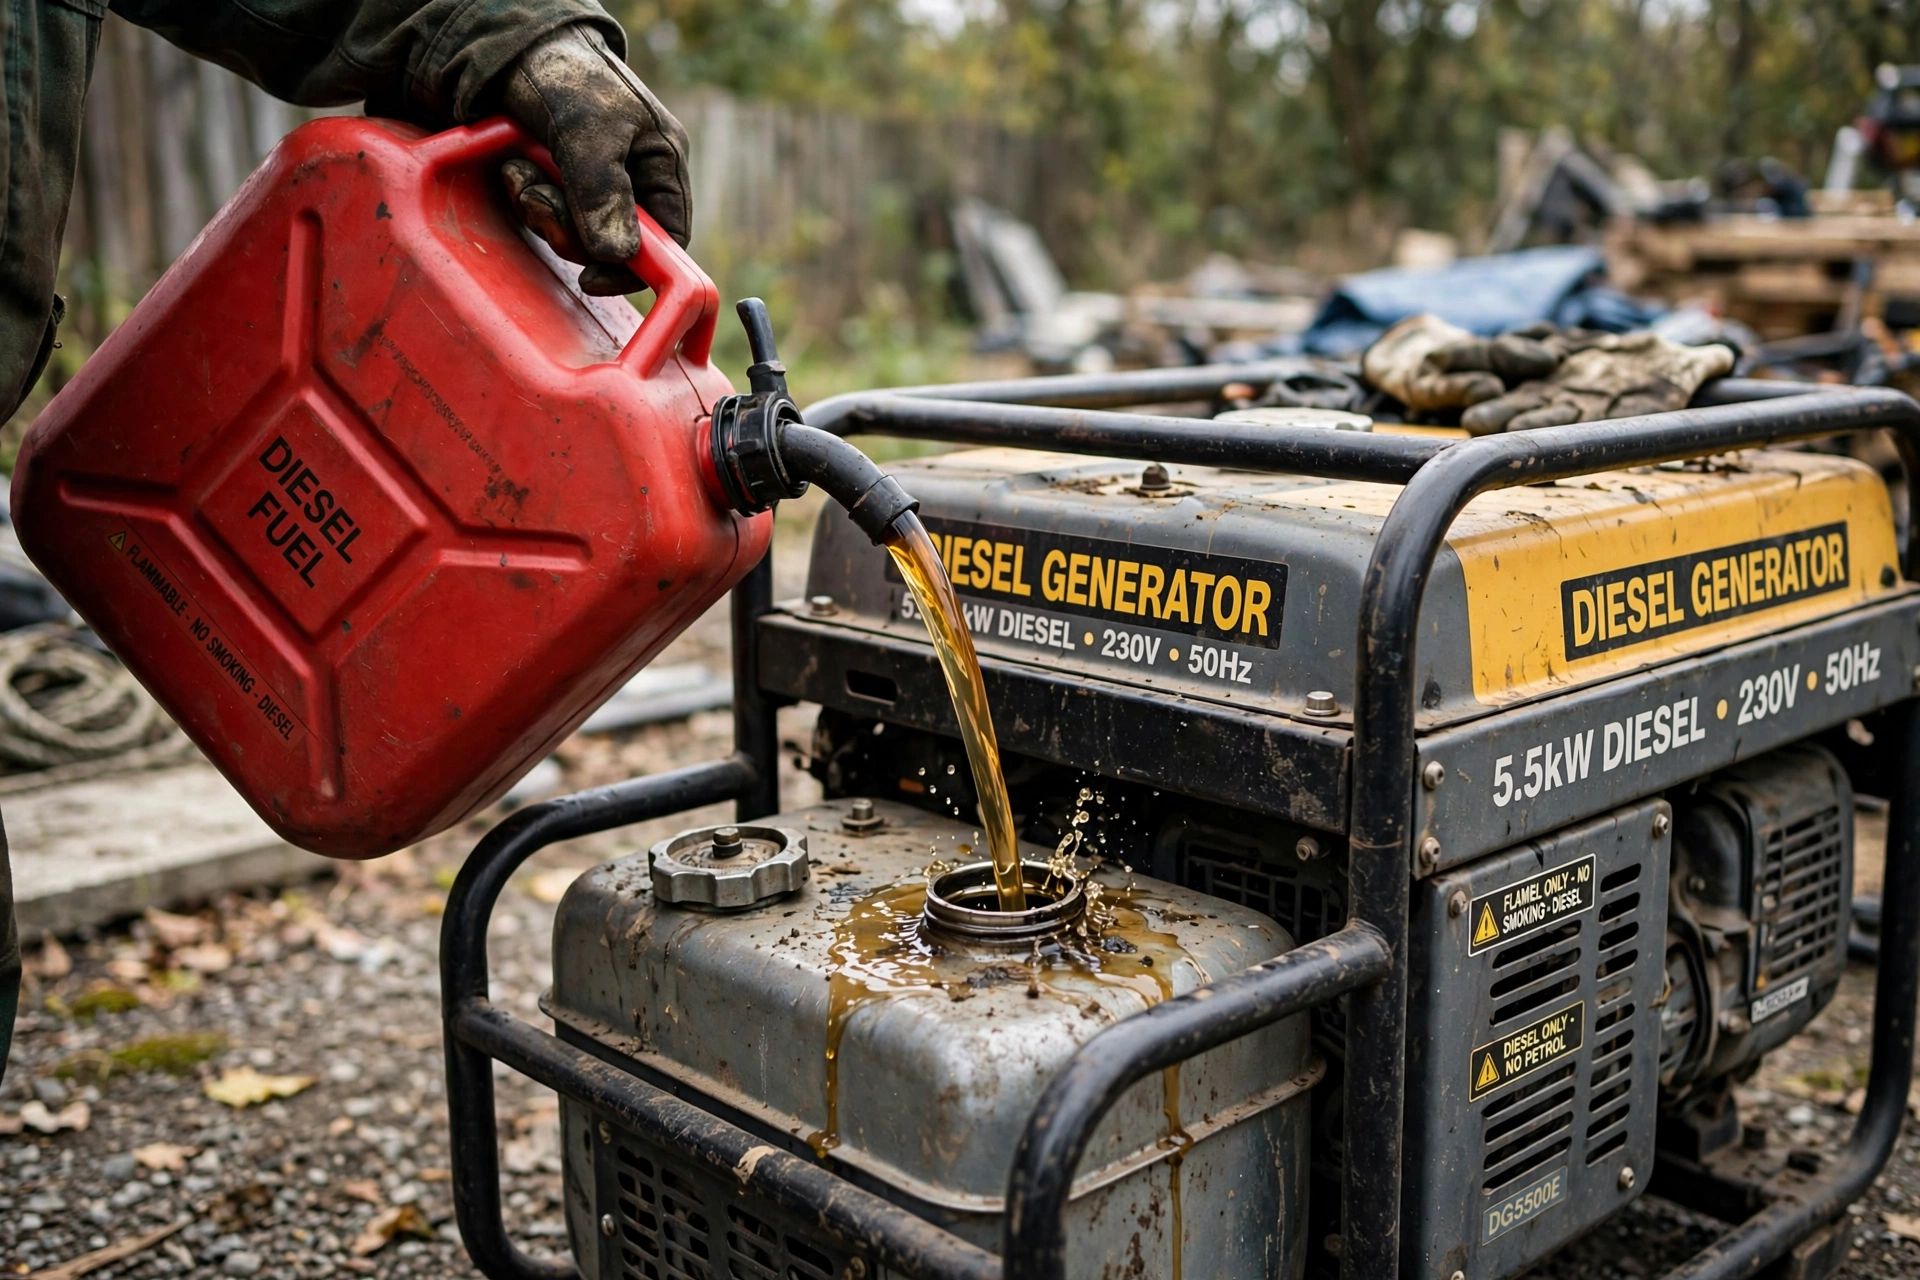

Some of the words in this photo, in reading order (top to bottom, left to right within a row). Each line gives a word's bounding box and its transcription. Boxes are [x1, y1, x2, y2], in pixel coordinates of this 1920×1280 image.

[247, 490, 324, 589] FUEL
[259, 435, 361, 564] DIESEL
[1041, 549, 1272, 636] GENERATOR
[1572, 570, 1684, 648] DIESEL
[1691, 532, 1845, 618] GENERATOR
[125, 543, 187, 621] FLAMMABLE
[190, 616, 207, 641] NO
[206, 637, 256, 695] SMOKING
[257, 695, 295, 741] DIESEL
[998, 609, 1075, 651] DIESEL
[1101, 629, 1162, 666] 230V
[1187, 645, 1253, 685] 50Hz
[1492, 728, 1595, 808] 5.5kW
[1603, 696, 1706, 772] DIESEL
[1737, 663, 1801, 726] 230V
[1824, 641, 1881, 696] 50Hz
[1502, 901, 1546, 934] SMOKING
[1503, 882, 1543, 913] FLAMEL
[1544, 871, 1569, 897] ONLY
[1577, 864, 1591, 884] NO
[1503, 1028, 1540, 1059] DIESEL
[1542, 1013, 1569, 1040] ONLY
[1505, 1054, 1522, 1077] NO
[1525, 1034, 1567, 1068] PETROL
[1487, 1174, 1561, 1238] DG5500E
